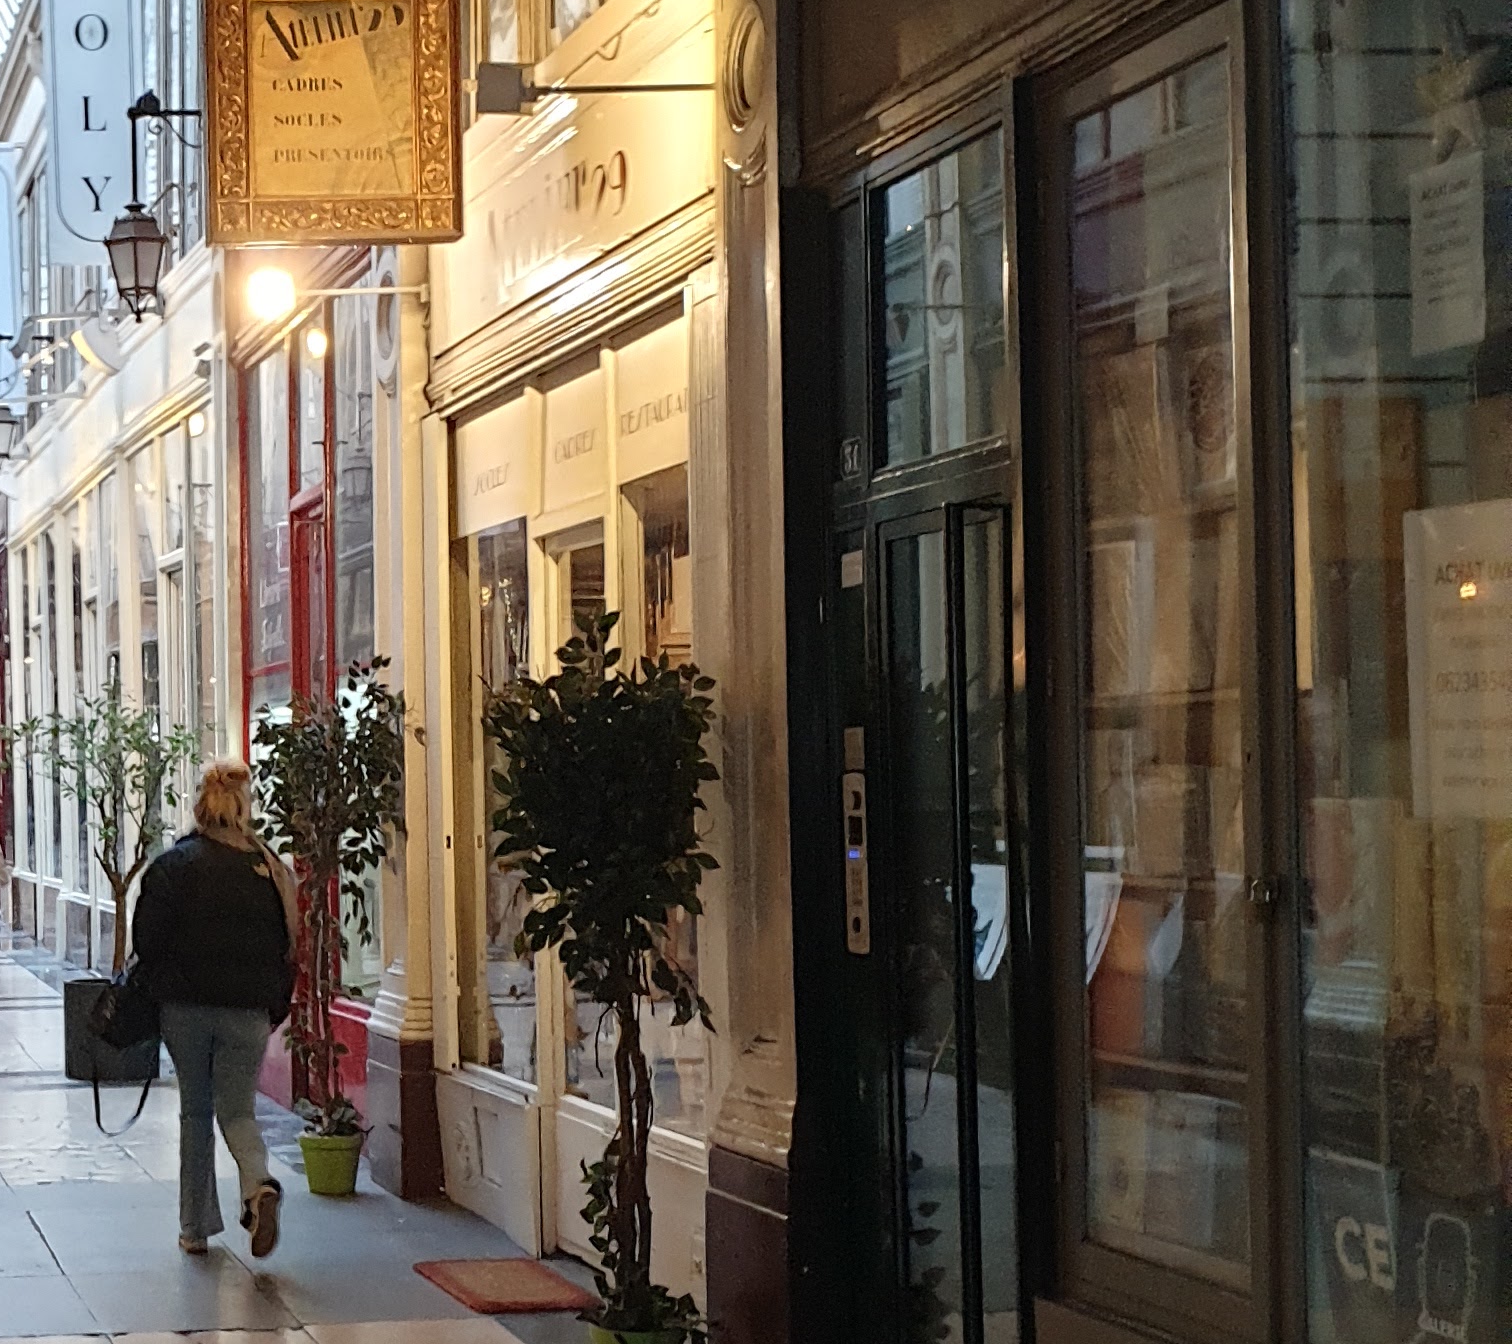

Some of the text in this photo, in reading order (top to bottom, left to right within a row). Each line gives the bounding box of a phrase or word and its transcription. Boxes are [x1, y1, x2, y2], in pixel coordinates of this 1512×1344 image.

[272, 77, 343, 92] CADRES
[273, 112, 342, 128] SOCLES
[554, 427, 597, 464] CADRES
